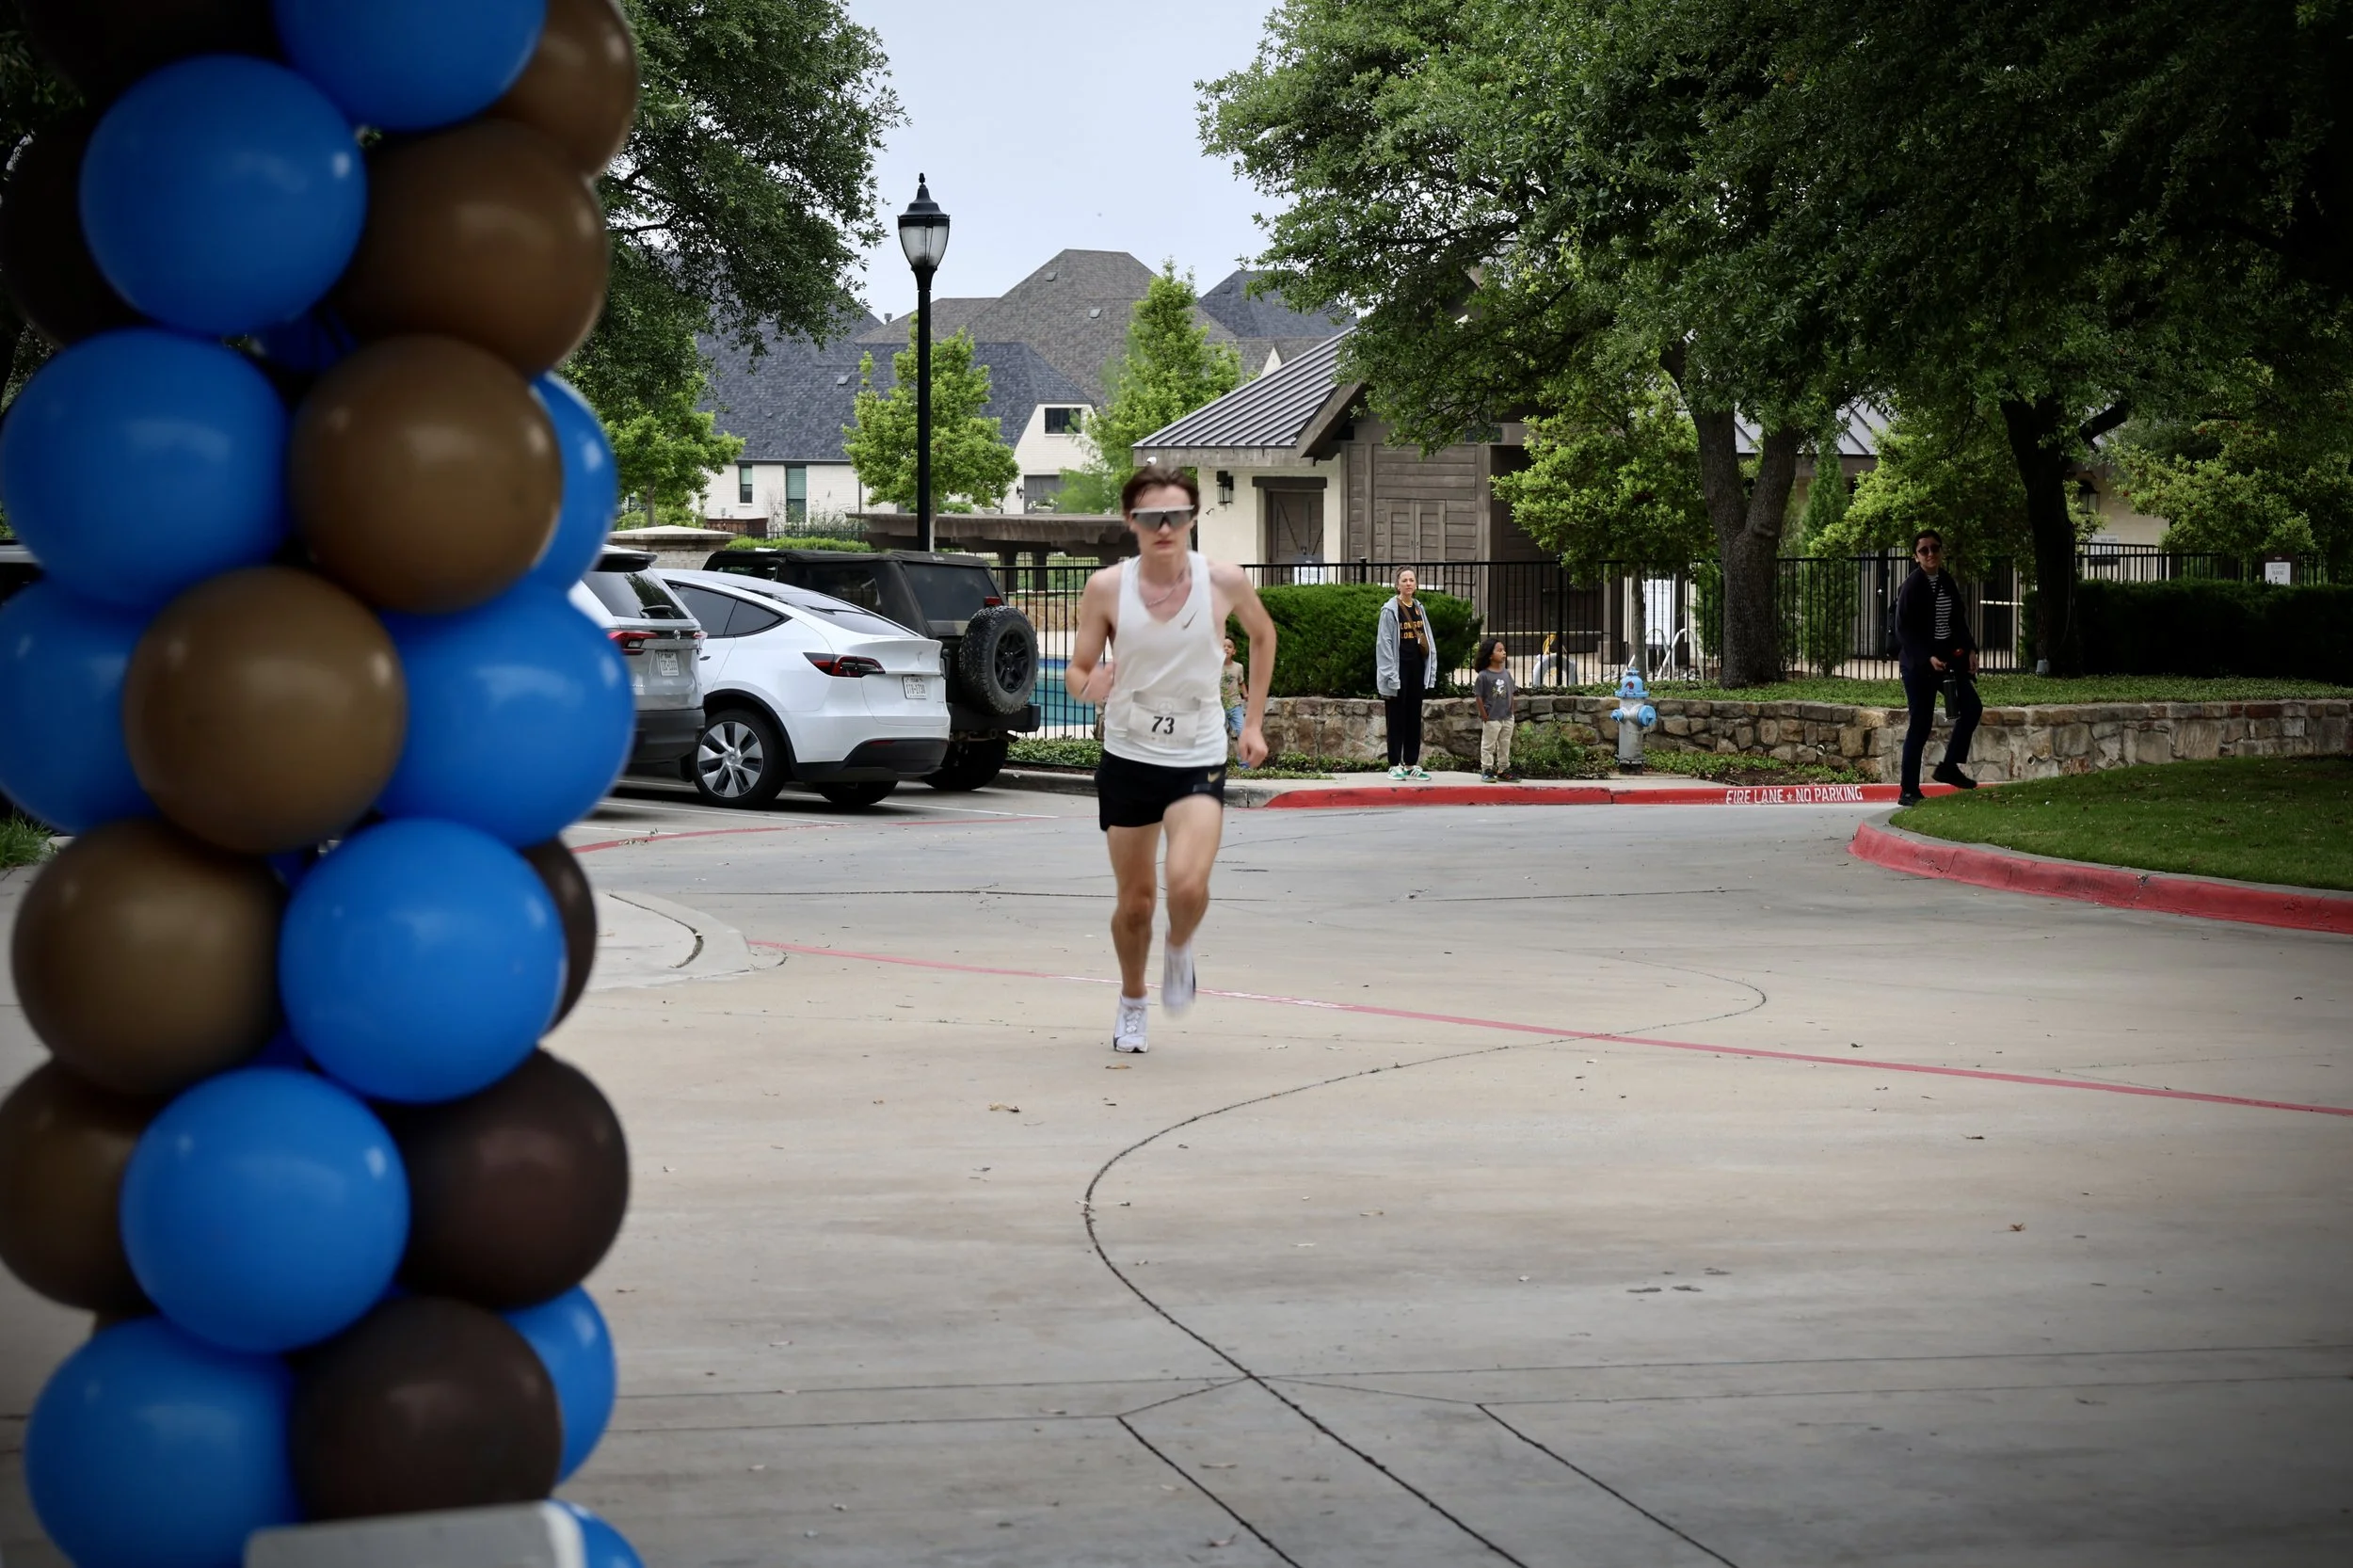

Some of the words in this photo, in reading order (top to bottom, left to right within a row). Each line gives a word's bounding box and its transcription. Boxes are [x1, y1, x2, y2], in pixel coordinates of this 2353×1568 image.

[1151, 715, 1175, 735] 73
[1725, 790, 1751, 805] FIRE
[1753, 789, 1785, 804] LANE
[1795, 788, 1812, 803] NO
[1814, 786, 1864, 802] PARKING
